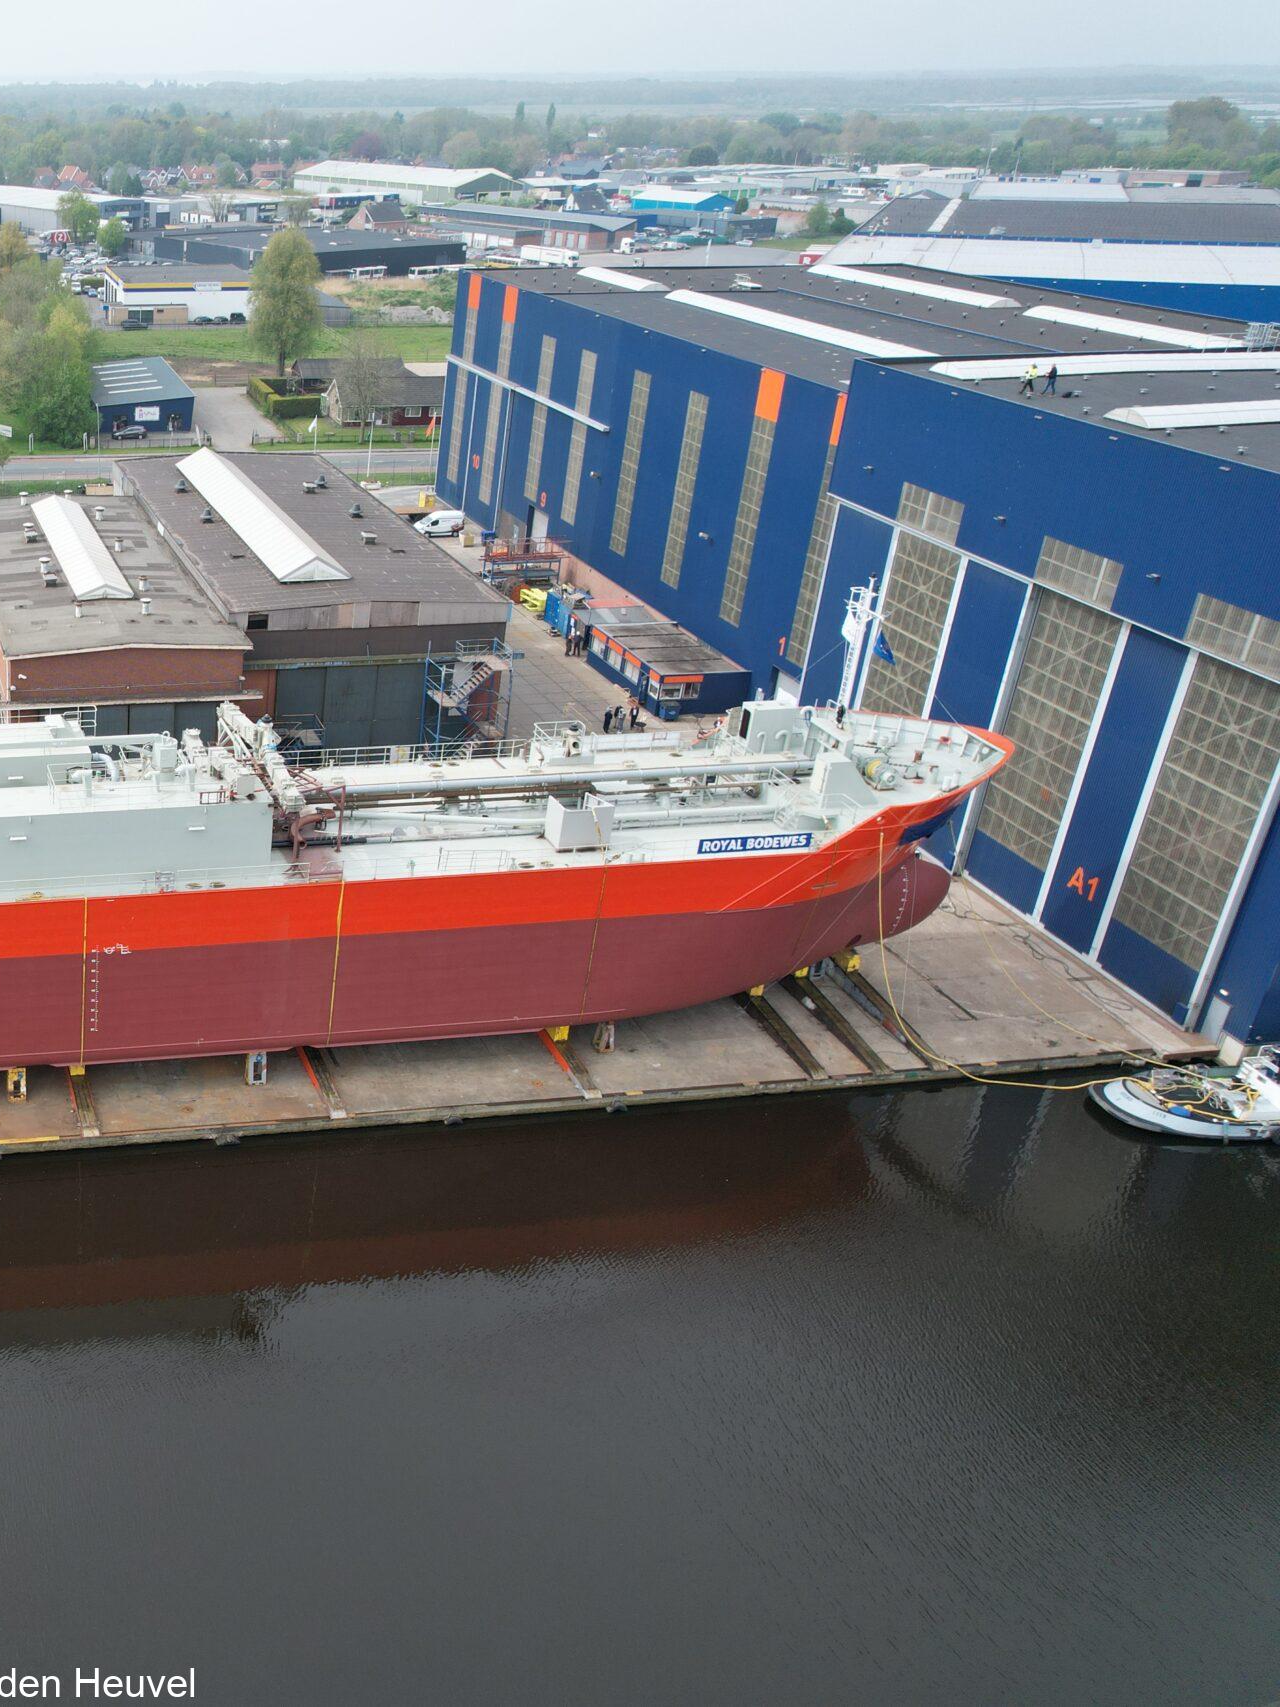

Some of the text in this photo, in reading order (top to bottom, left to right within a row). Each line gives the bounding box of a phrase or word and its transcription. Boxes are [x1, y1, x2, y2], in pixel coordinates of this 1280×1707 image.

[778, 636, 786, 656] 1
[701, 835, 807, 852] ROYAL BODEWES
[1066, 866, 1099, 901] A1
